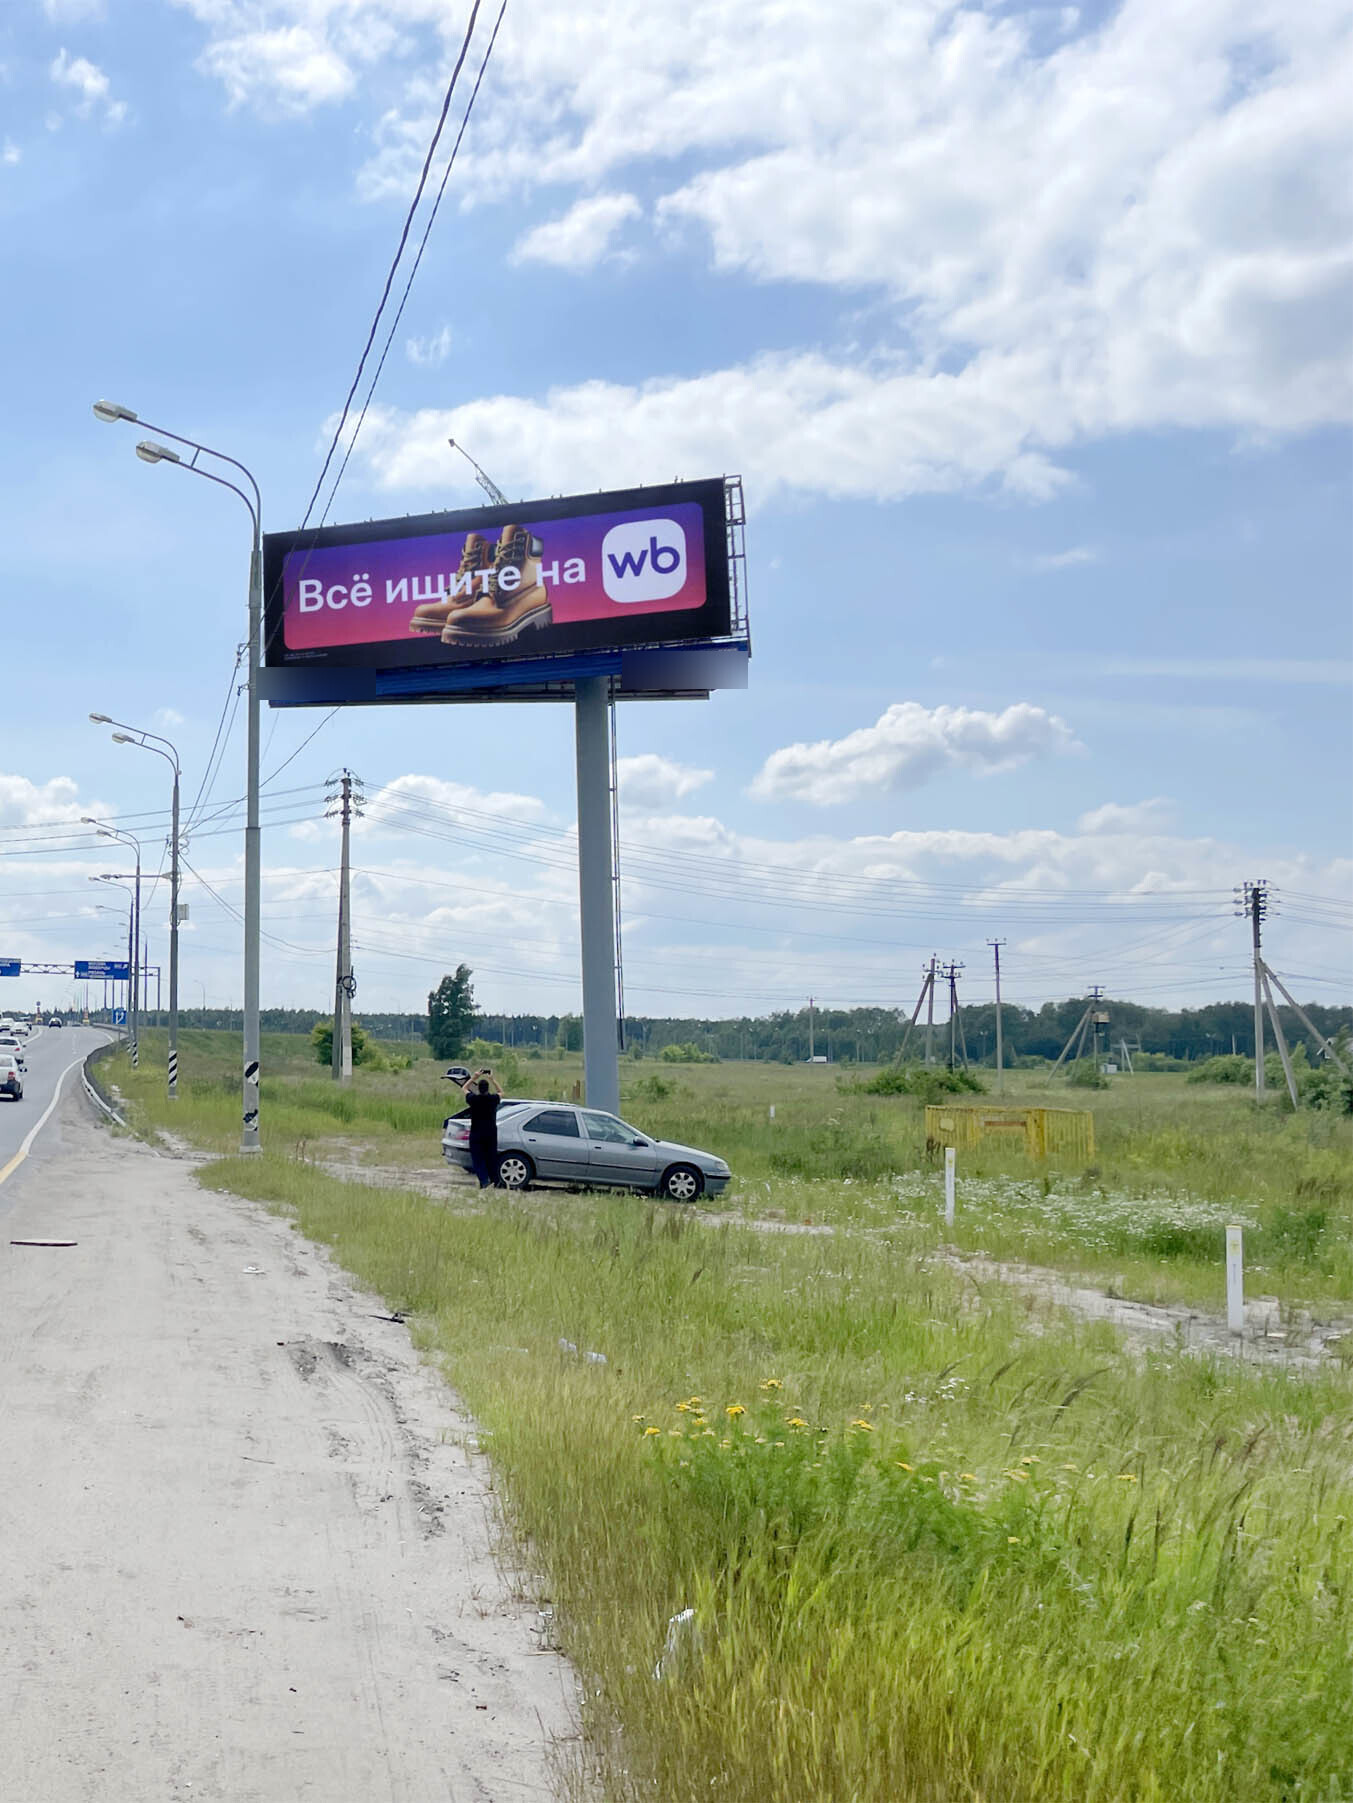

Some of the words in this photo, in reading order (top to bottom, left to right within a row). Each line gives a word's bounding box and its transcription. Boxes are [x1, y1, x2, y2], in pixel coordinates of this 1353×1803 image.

[607, 536, 681, 579] wb
[299, 573, 372, 613] Всё
[386, 564, 521, 603] ищите
[535, 557, 586, 587] на
